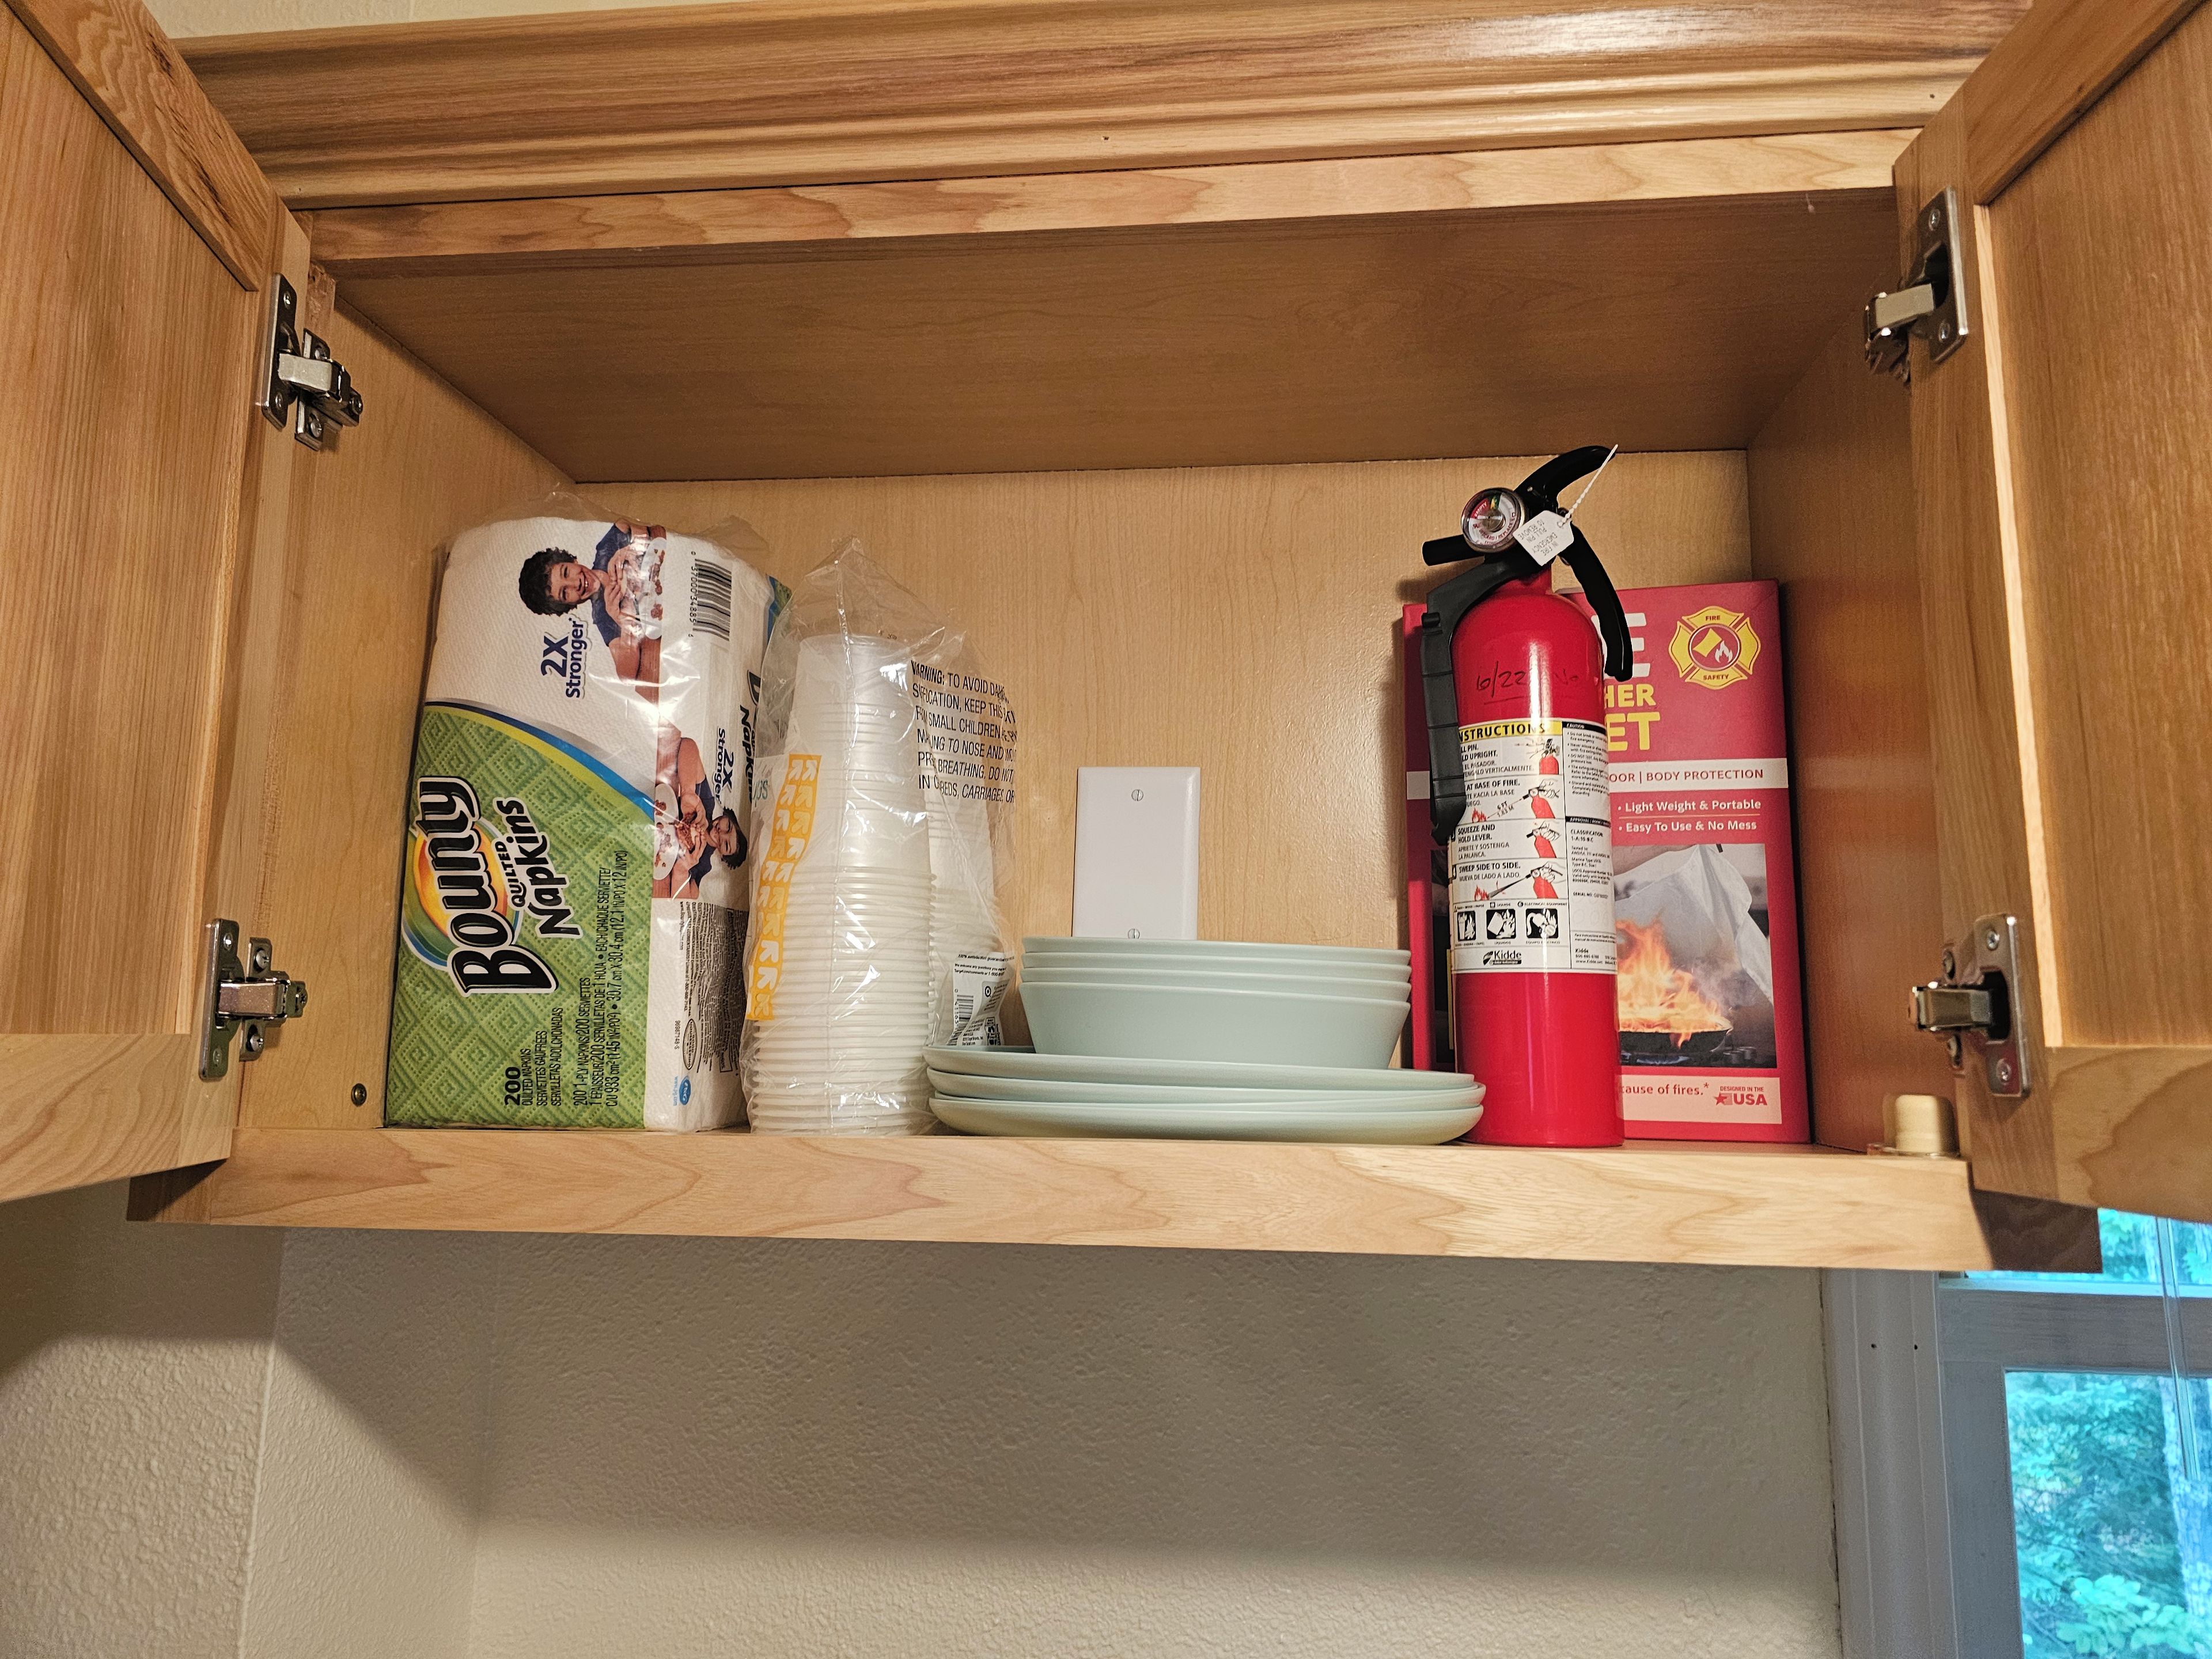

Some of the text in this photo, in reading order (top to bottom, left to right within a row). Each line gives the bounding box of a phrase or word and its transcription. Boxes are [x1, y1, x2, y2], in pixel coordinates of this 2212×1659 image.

[1518, 524, 1538, 540] REMOVE
[1527, 527, 1547, 543] PULL PIN
[1532, 532, 1558, 553] EMERGENCY
[1540, 546, 1552, 556] FIRE
[690, 595, 698, 623] 34885
[540, 635, 569, 677] 2X
[948, 672, 960, 688] TO
[963, 676, 988, 694] AVOID
[1604, 684, 1656, 709] HER
[965, 698, 986, 714] KEEP
[988, 702, 1002, 719] THIS
[929, 712, 956, 731] SMALL
[959, 718, 1001, 739] CHILDREN
[1459, 724, 1545, 743] NSTRUCTIONS
[1605, 712, 1660, 751] ET
[949, 738, 959, 753] TO
[962, 740, 985, 757] NOSE
[986, 745, 1004, 760] AND
[1468, 744, 1479, 752] PIN.
[1469, 749, 1498, 760] UPRIGHT.
[723, 748, 734, 790] 2X
[938, 759, 986, 779] BREATHING.
[988, 766, 1000, 781] DO
[1471, 760, 1497, 770] PASADOR.
[1485, 765, 1534, 774] VERTICALMENTE.
[919, 775, 930, 789] IN
[1608, 769, 1764, 782] OOR BODY PROTECTION
[1467, 782, 1474, 791] AT
[1475, 781, 1490, 790] BASE
[1491, 780, 1501, 788] OF
[1625, 799, 1761, 814] Light Weight & Portable
[1458, 824, 1495, 835] SQUEEZE AND
[1626, 820, 1757, 834] Easy To Use & No Mess
[1458, 834, 1493, 844] HOLD LEVER.
[1458, 843, 1475, 853] APRIETE
[1480, 842, 1509, 850] SOSTENGA
[614, 850, 628, 870] IN/PO)
[1463, 851, 1486, 859] PALANCA.
[495, 840, 527, 908] QUILTED
[496, 800, 581, 935] Napkins
[612, 871, 627, 882] 12
[1459, 865, 1475, 874] SWEEP
[1476, 863, 1490, 871] SIDE
[1502, 861, 1521, 869] SIDE.
[1459, 873, 1473, 882] MUEVA
[1503, 870, 1521, 878] LADO.
[415, 774, 558, 994] Bounty
[597, 867, 611, 904] SERVIETTE/
[613, 893, 626, 907] IN/PO
[596, 906, 609, 952] EACH/CHAQUE
[609, 910, 625, 931] (12.1
[614, 932, 624, 942] cm
[608, 944, 623, 962] 30.4
[1493, 950, 1522, 960] Kidde
[594, 962, 607, 980] HOJA
[612, 971, 622, 980] cm
[594, 989, 605, 998] DE
[607, 983, 622, 1001] 30.7
[594, 1000, 605, 1043] SERVILLETAS
[573, 978, 590, 1106] 200 1-PLY NAPKINS/200 SERVIETTES
[606, 1041, 621, 1059] (145
[550, 1007, 563, 1106] SERVILLETAS ACOLCHONADAS
[520, 1048, 533, 1106] QUILTED NAPKINS
[605, 1077, 619, 1093] 933
[505, 1067, 521, 1106] 200
[535, 1067, 548, 1106] SERVIETTES
[1657, 1084, 1670, 1094] of
[606, 1095, 618, 1106] C/U
[1733, 1093, 1768, 1106] USA
